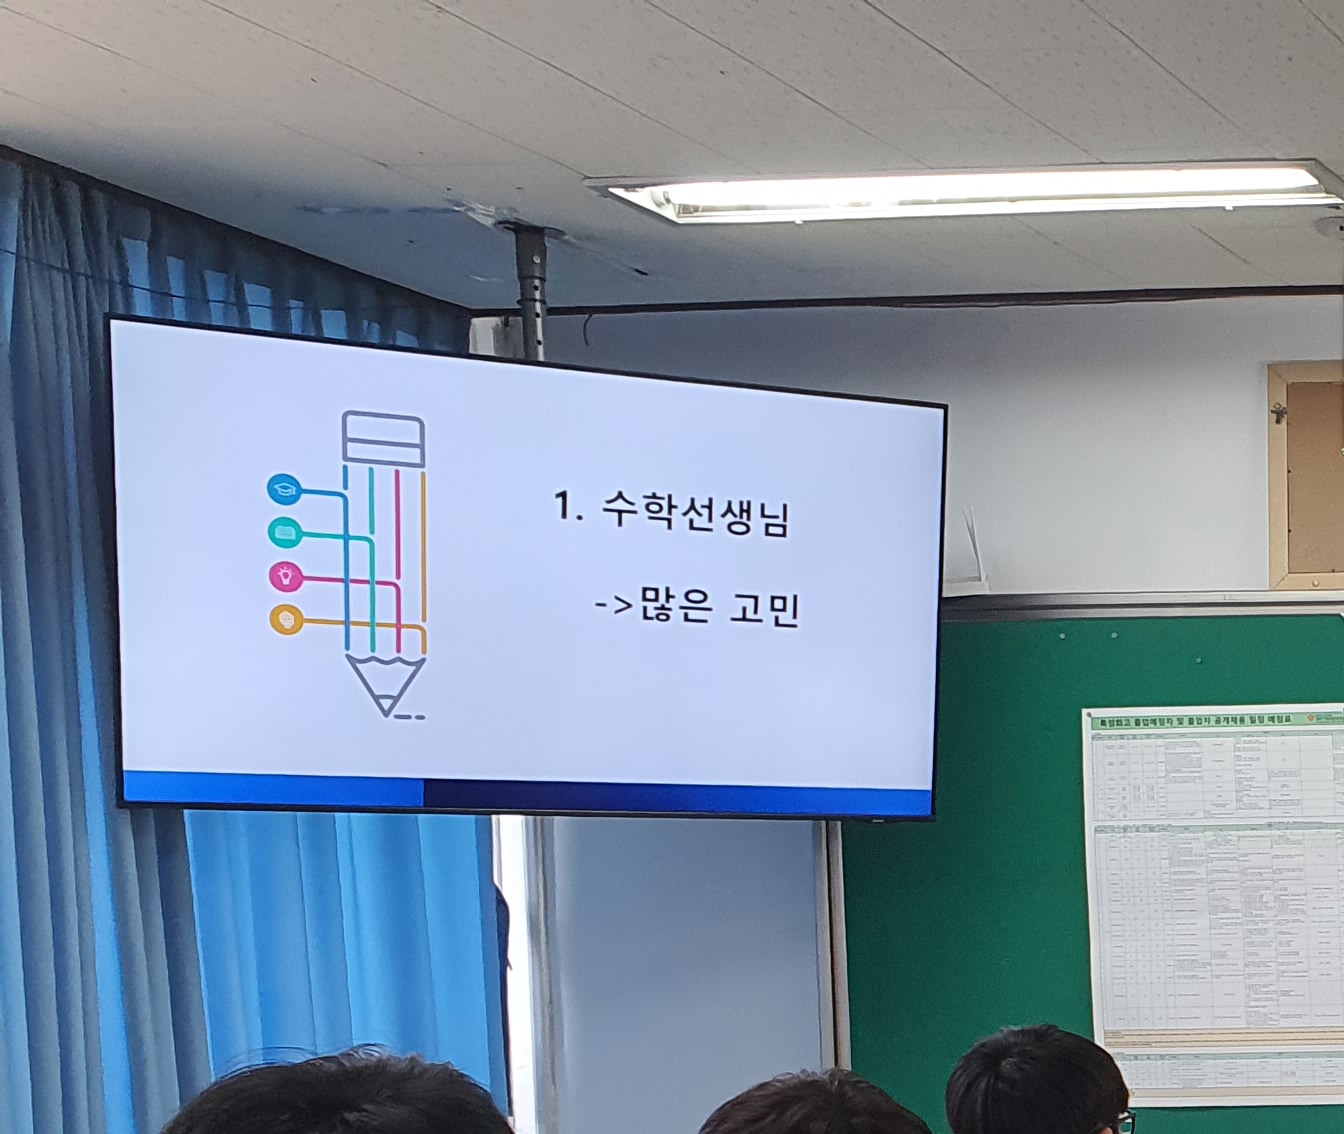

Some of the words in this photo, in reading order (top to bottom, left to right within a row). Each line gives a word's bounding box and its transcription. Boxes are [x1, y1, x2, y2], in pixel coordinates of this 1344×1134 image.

[555, 490, 583, 521] 1.
[602, 490, 788, 538] 수학선생님
[730, 594, 798, 628] 고민
